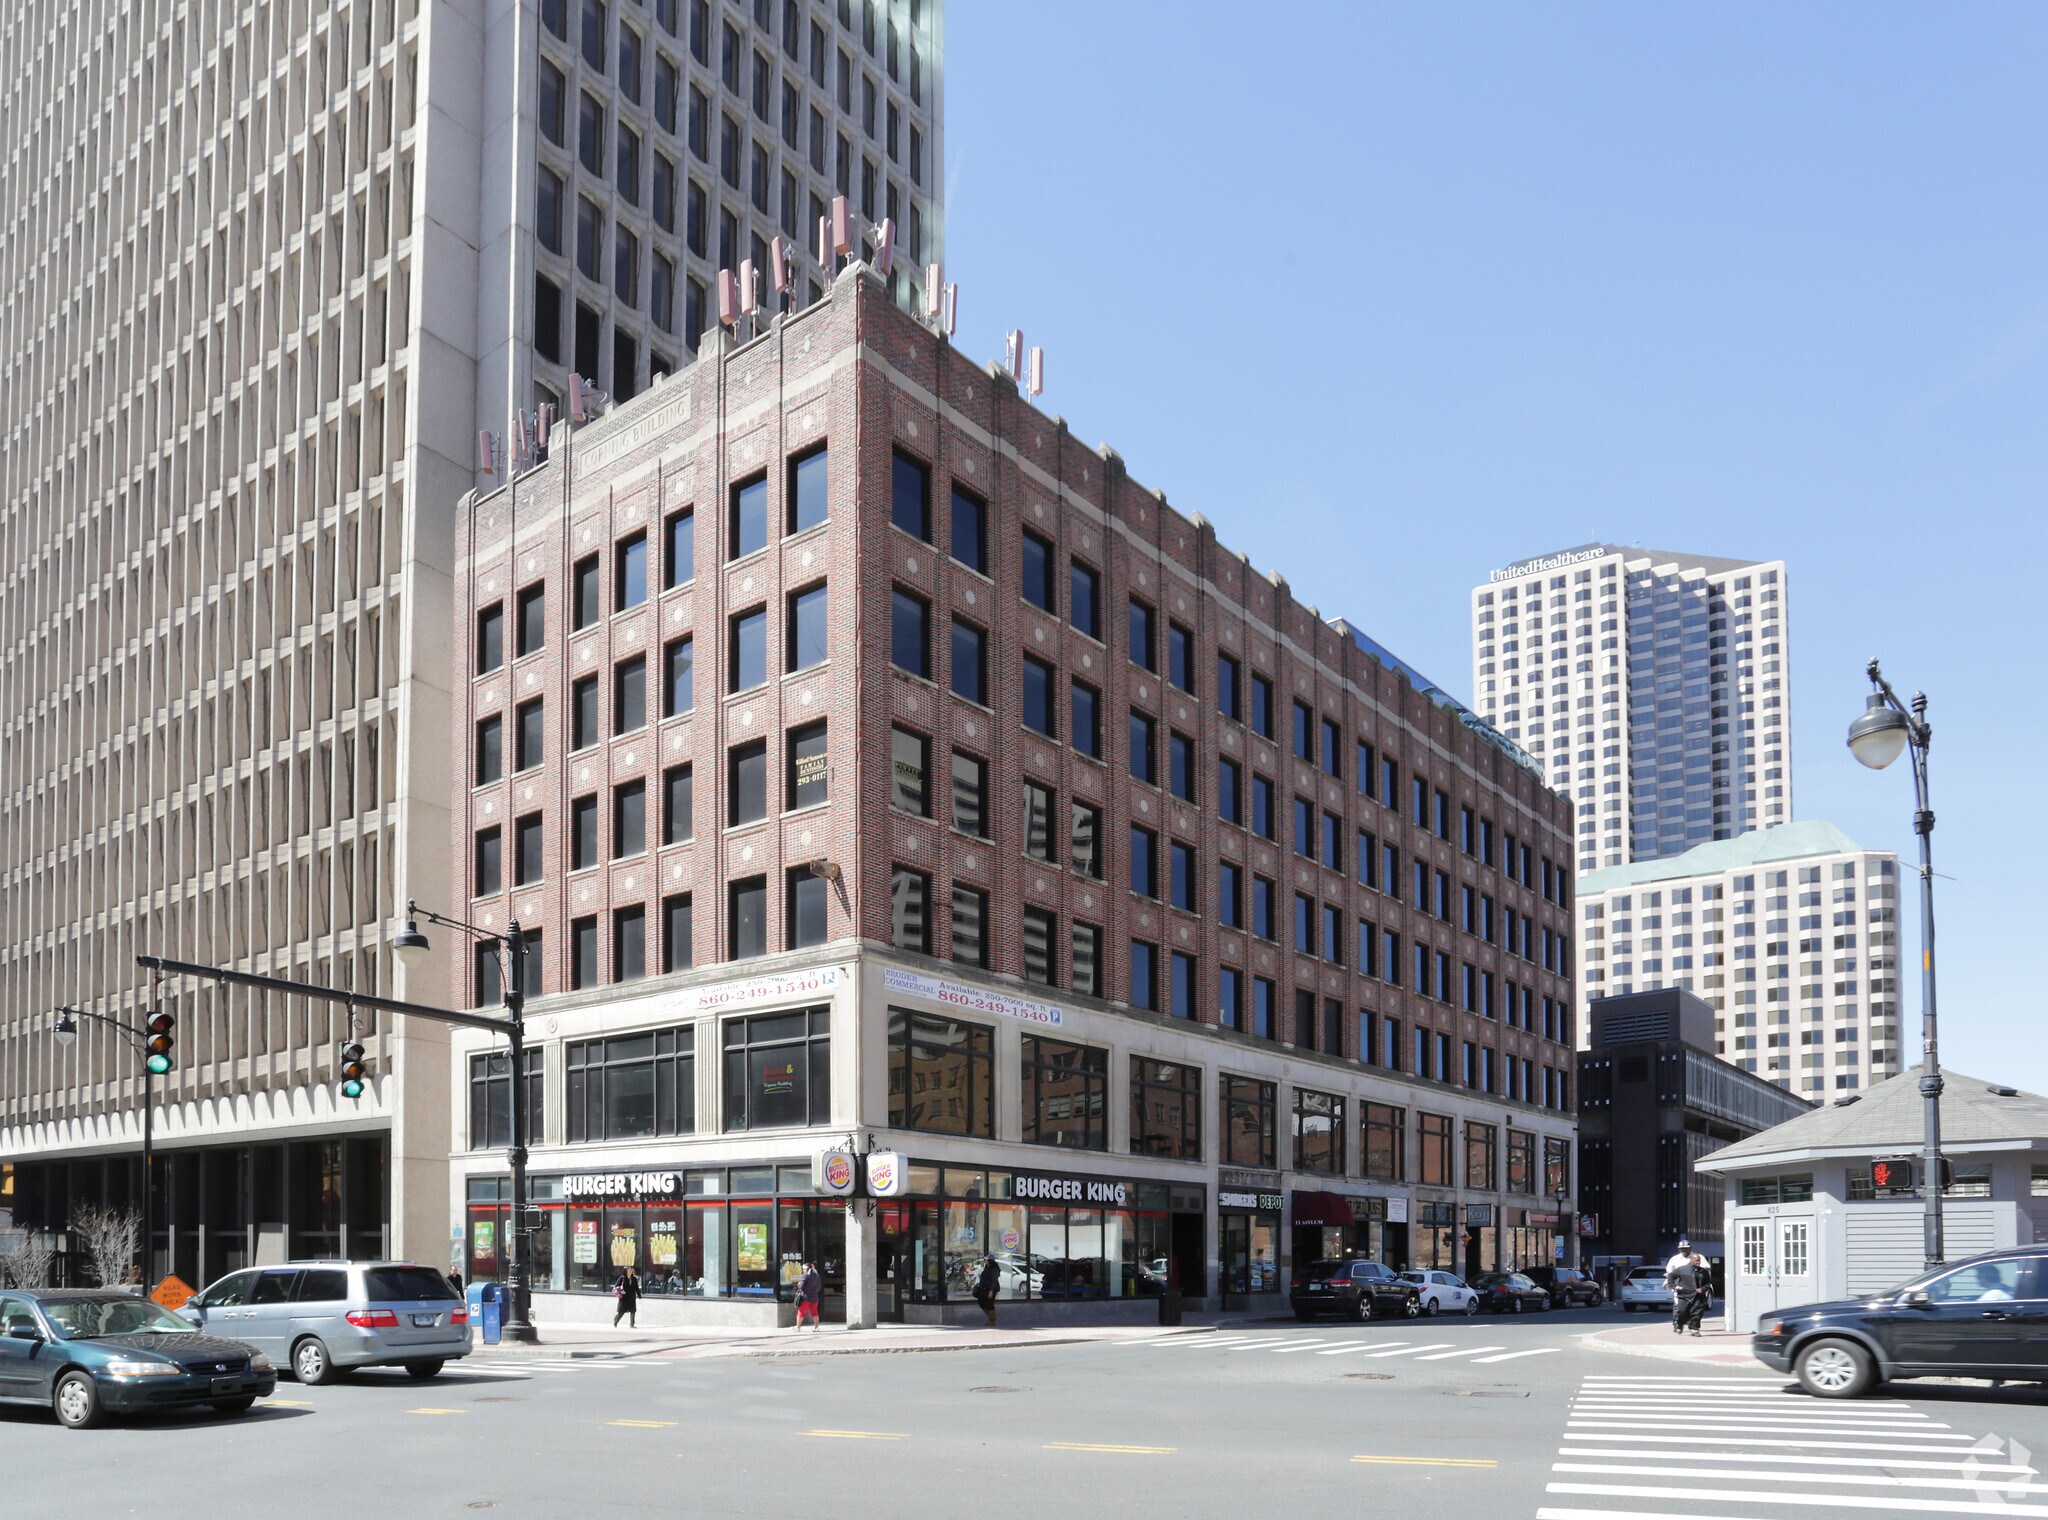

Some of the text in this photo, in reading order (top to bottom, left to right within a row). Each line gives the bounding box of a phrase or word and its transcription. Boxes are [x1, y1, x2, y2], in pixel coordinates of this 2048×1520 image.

[633, 400, 685, 442] BUILDING
[1490, 547, 1604, 582] UnitedHealthcare
[800, 758, 825, 770] FAMILY
[797, 771, 827, 786] 293-0117
[886, 969, 918, 983] BRODER
[698, 979, 819, 1006] 860-249-1540
[886, 978, 935, 994] COMMERCIAL
[939, 981, 983, 997] Available:
[984, 992, 1024, 1007] 250-7000
[1025, 1002, 1037, 1012] sq.
[938, 990, 1048, 1023] 860-249-1540
[829, 1162, 848, 1173] BURGER
[829, 1169, 850, 1182] KING
[872, 1163, 891, 1175] BURGER
[562, 1172, 675, 1196] BURGER KING
[872, 1169, 892, 1183] KING
[1016, 1177, 1126, 1203] BURGER KING
[1260, 1194, 1285, 1210] DEPOT
[1767, 1206, 1779, 1214] 825
